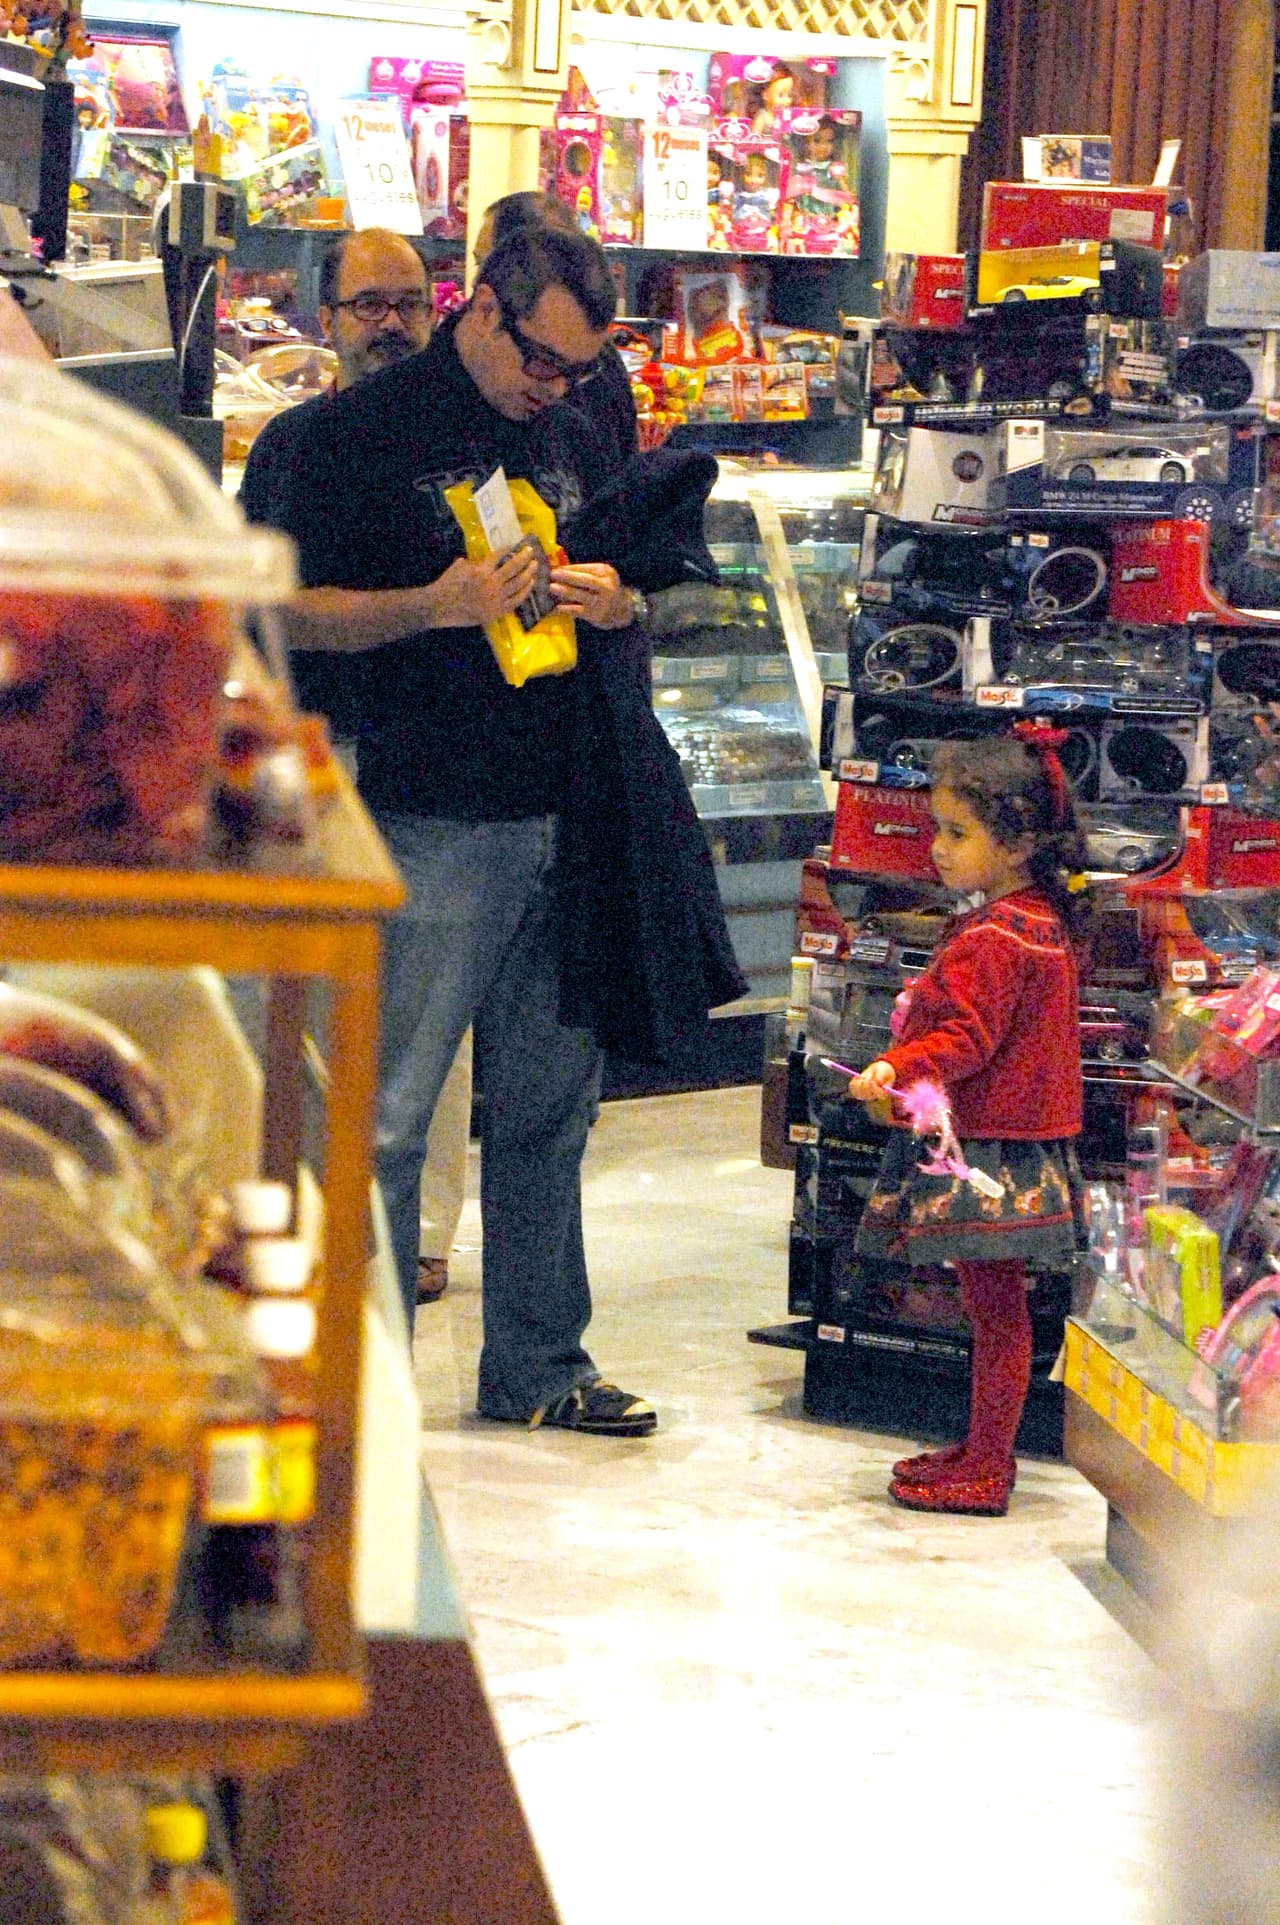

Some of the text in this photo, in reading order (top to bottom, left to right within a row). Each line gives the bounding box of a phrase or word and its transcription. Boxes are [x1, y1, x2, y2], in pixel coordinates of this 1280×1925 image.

[341, 114, 365, 141] 12
[652, 132, 670, 159] 12
[663, 181, 688, 201] 10
[980, 689, 1019, 705] Maisto
